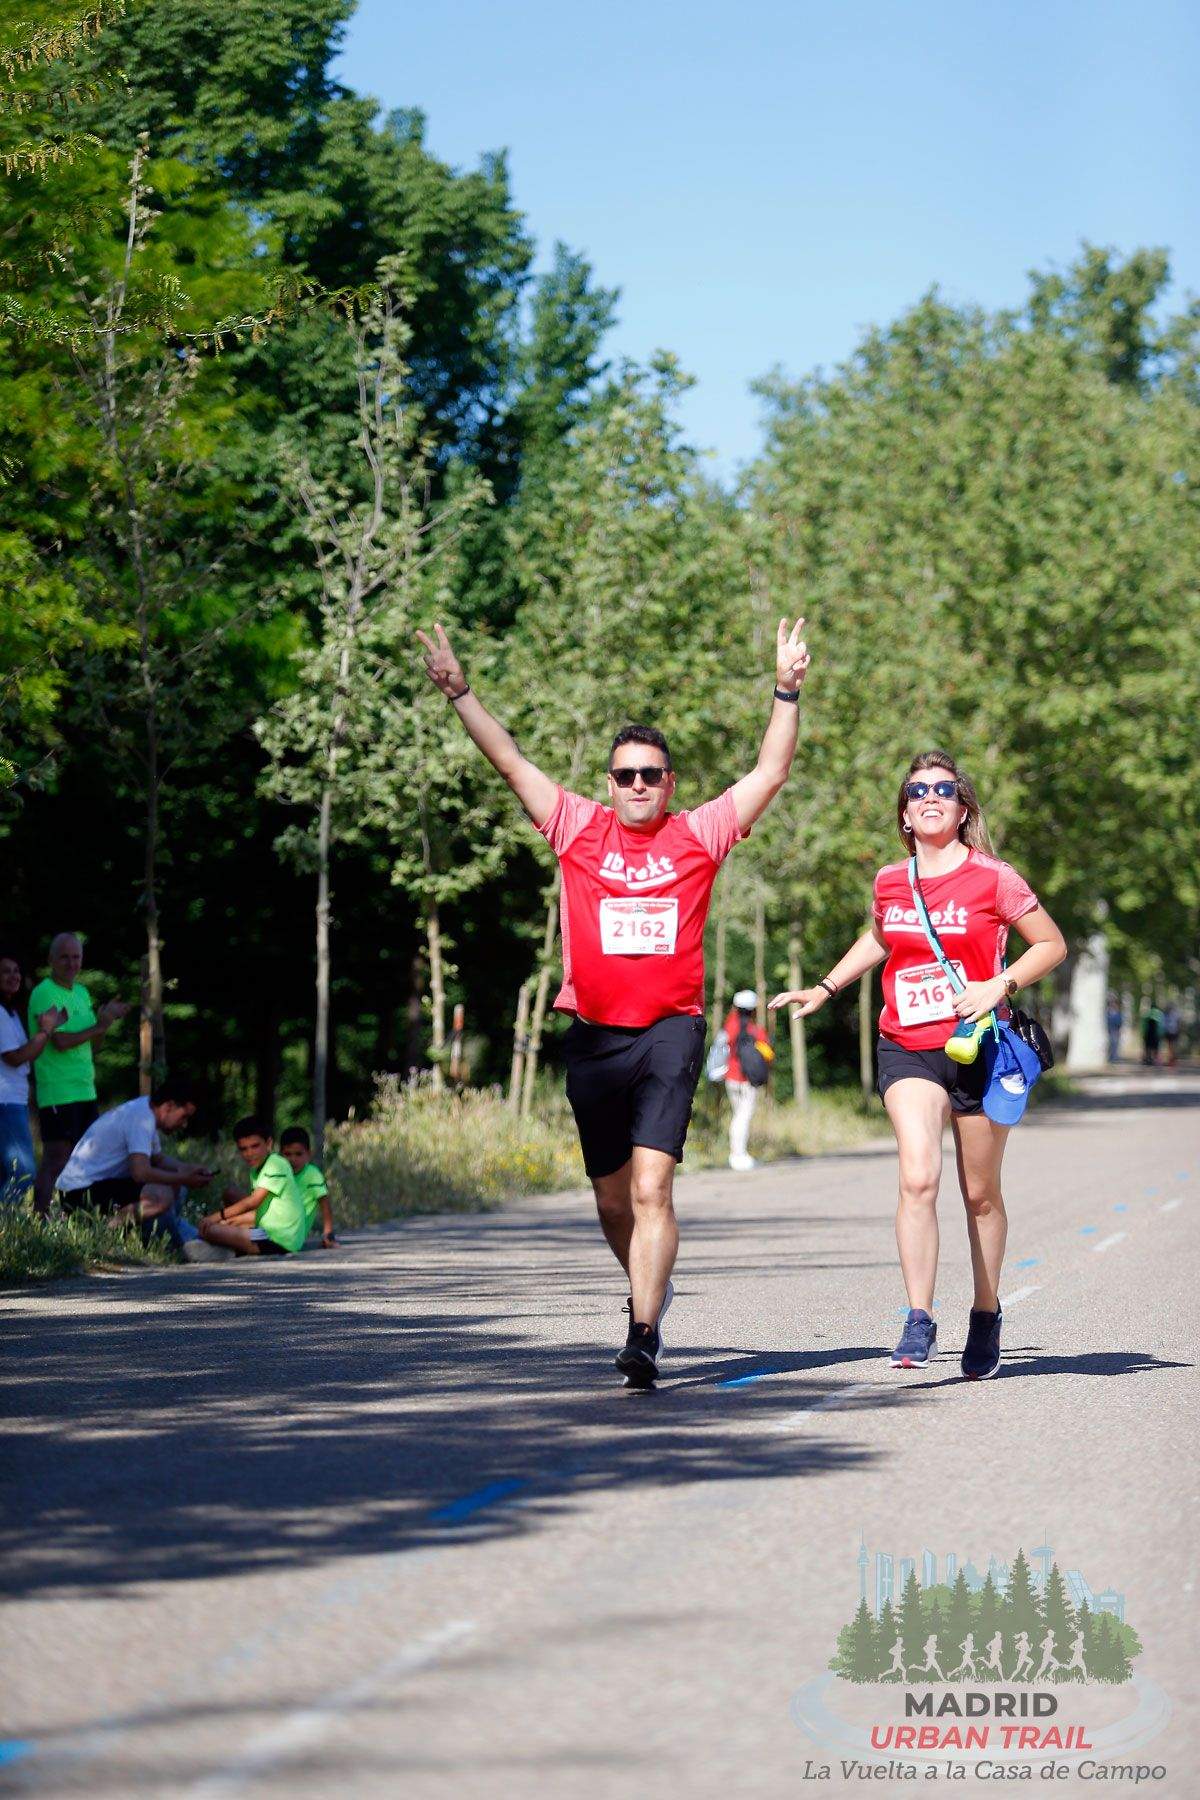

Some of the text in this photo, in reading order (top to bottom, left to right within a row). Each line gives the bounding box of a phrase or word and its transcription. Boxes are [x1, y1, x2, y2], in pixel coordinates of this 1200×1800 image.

[602, 851, 674, 882] Ibrext
[884, 899, 969, 926] Ibeext
[612, 920, 666, 938] 2162
